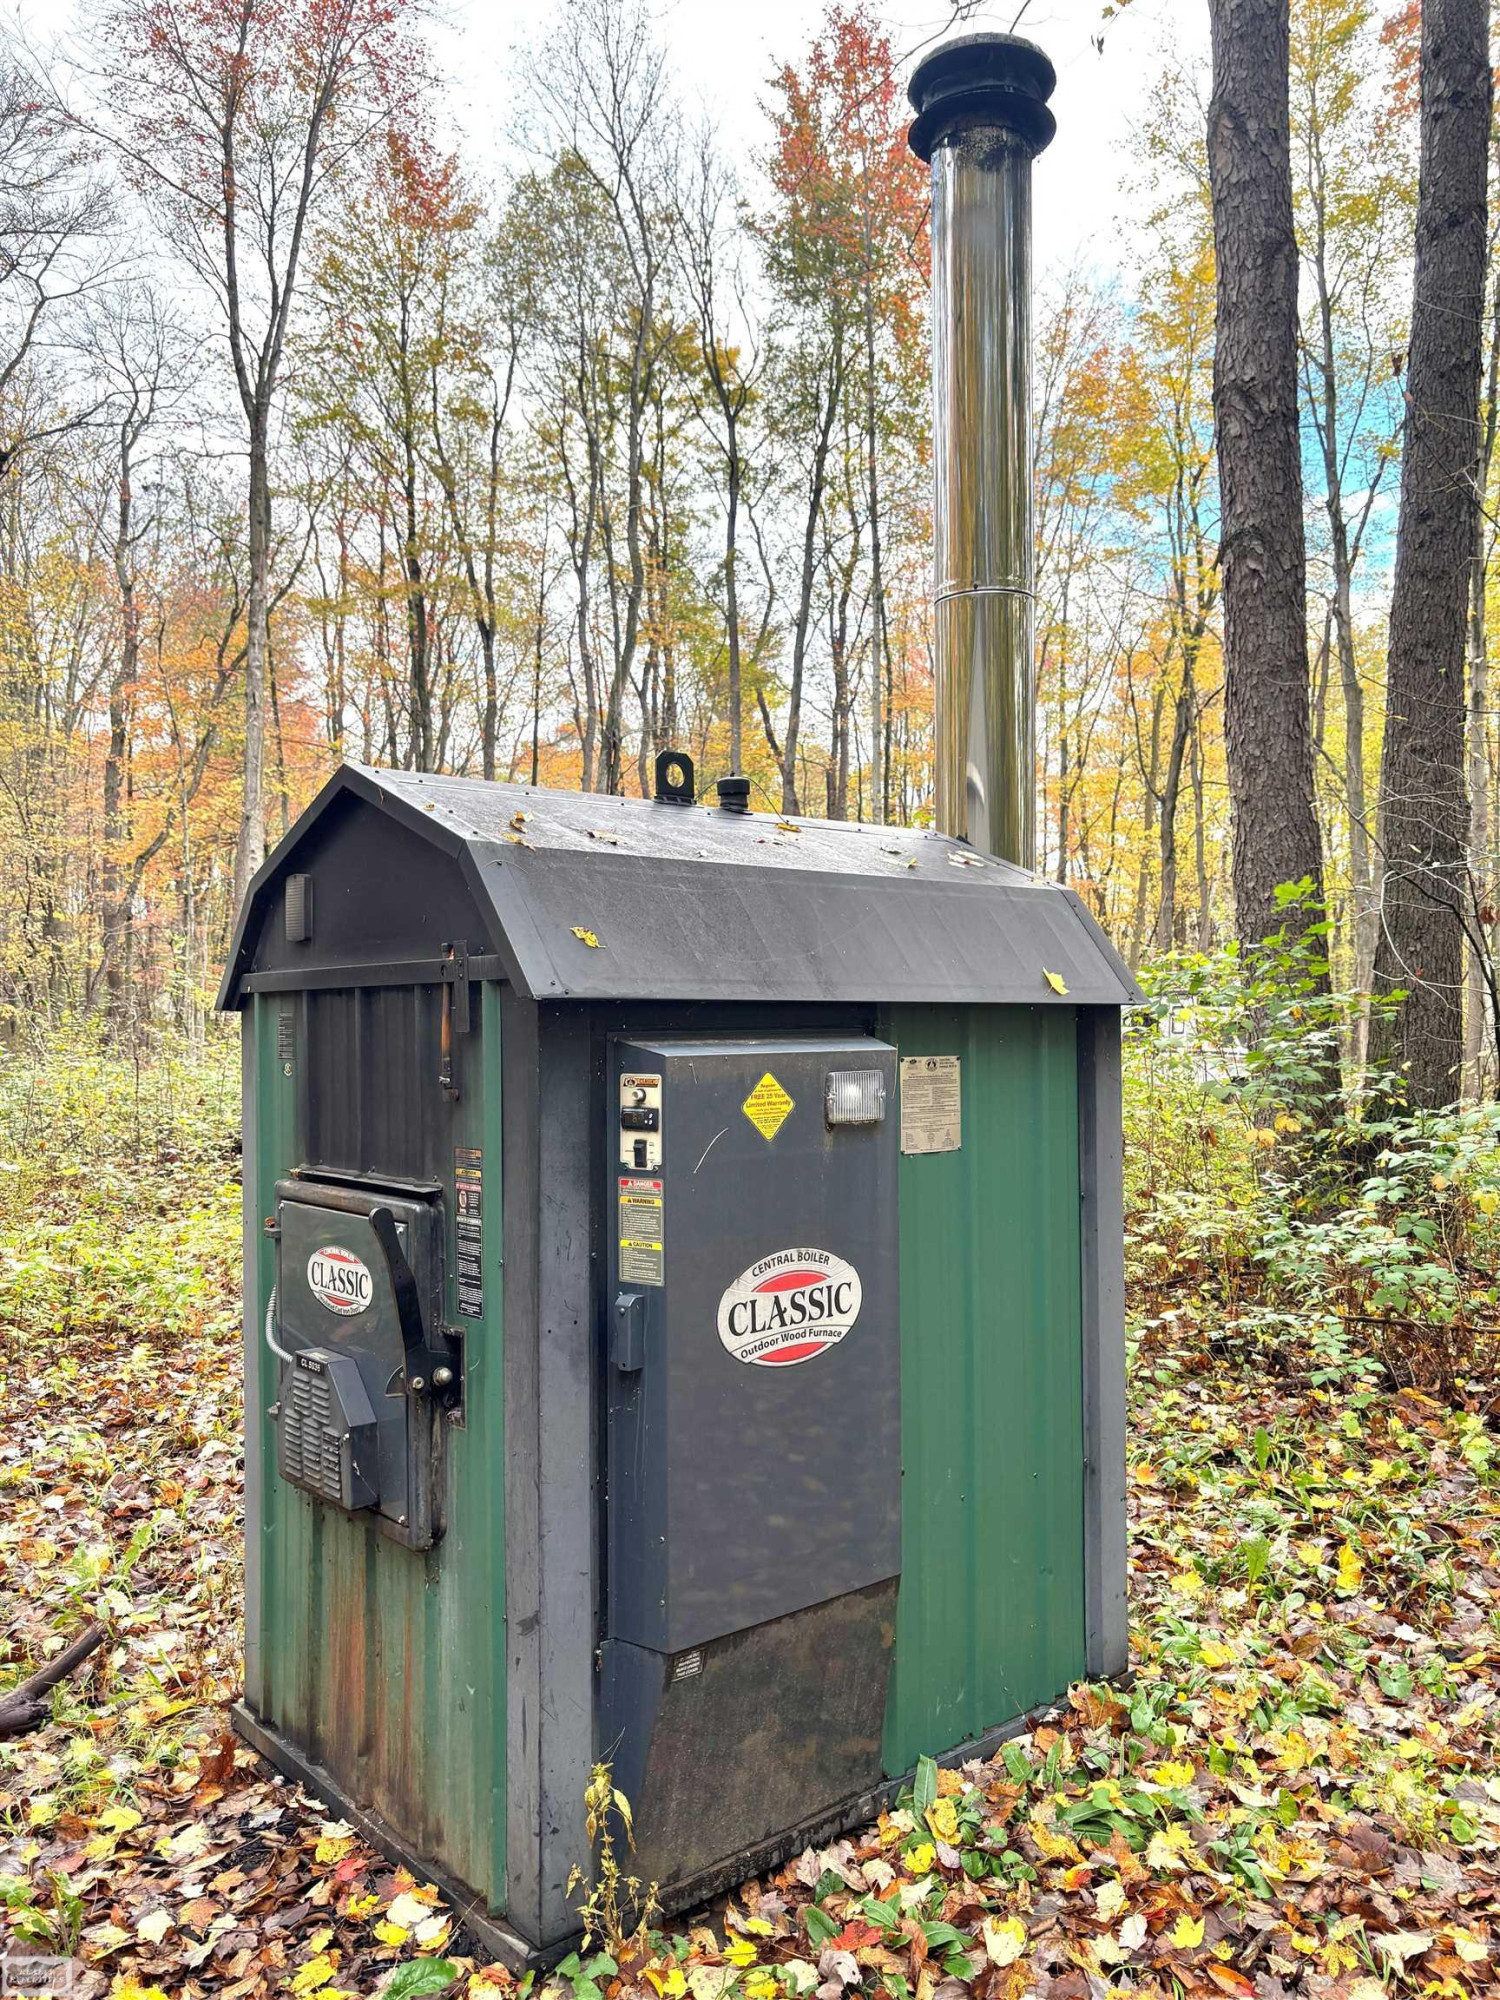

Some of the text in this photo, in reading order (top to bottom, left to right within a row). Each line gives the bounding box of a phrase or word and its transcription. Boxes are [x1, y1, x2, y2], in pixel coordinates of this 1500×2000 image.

[767, 1100, 791, 1108] Warranty
[312, 1261, 368, 1299] CLASSIC
[752, 1252, 830, 1277] CENTRAL BOILER
[728, 1282, 852, 1337] CLASSIC
[740, 1328, 842, 1359] Outdoor Wood Furnace
